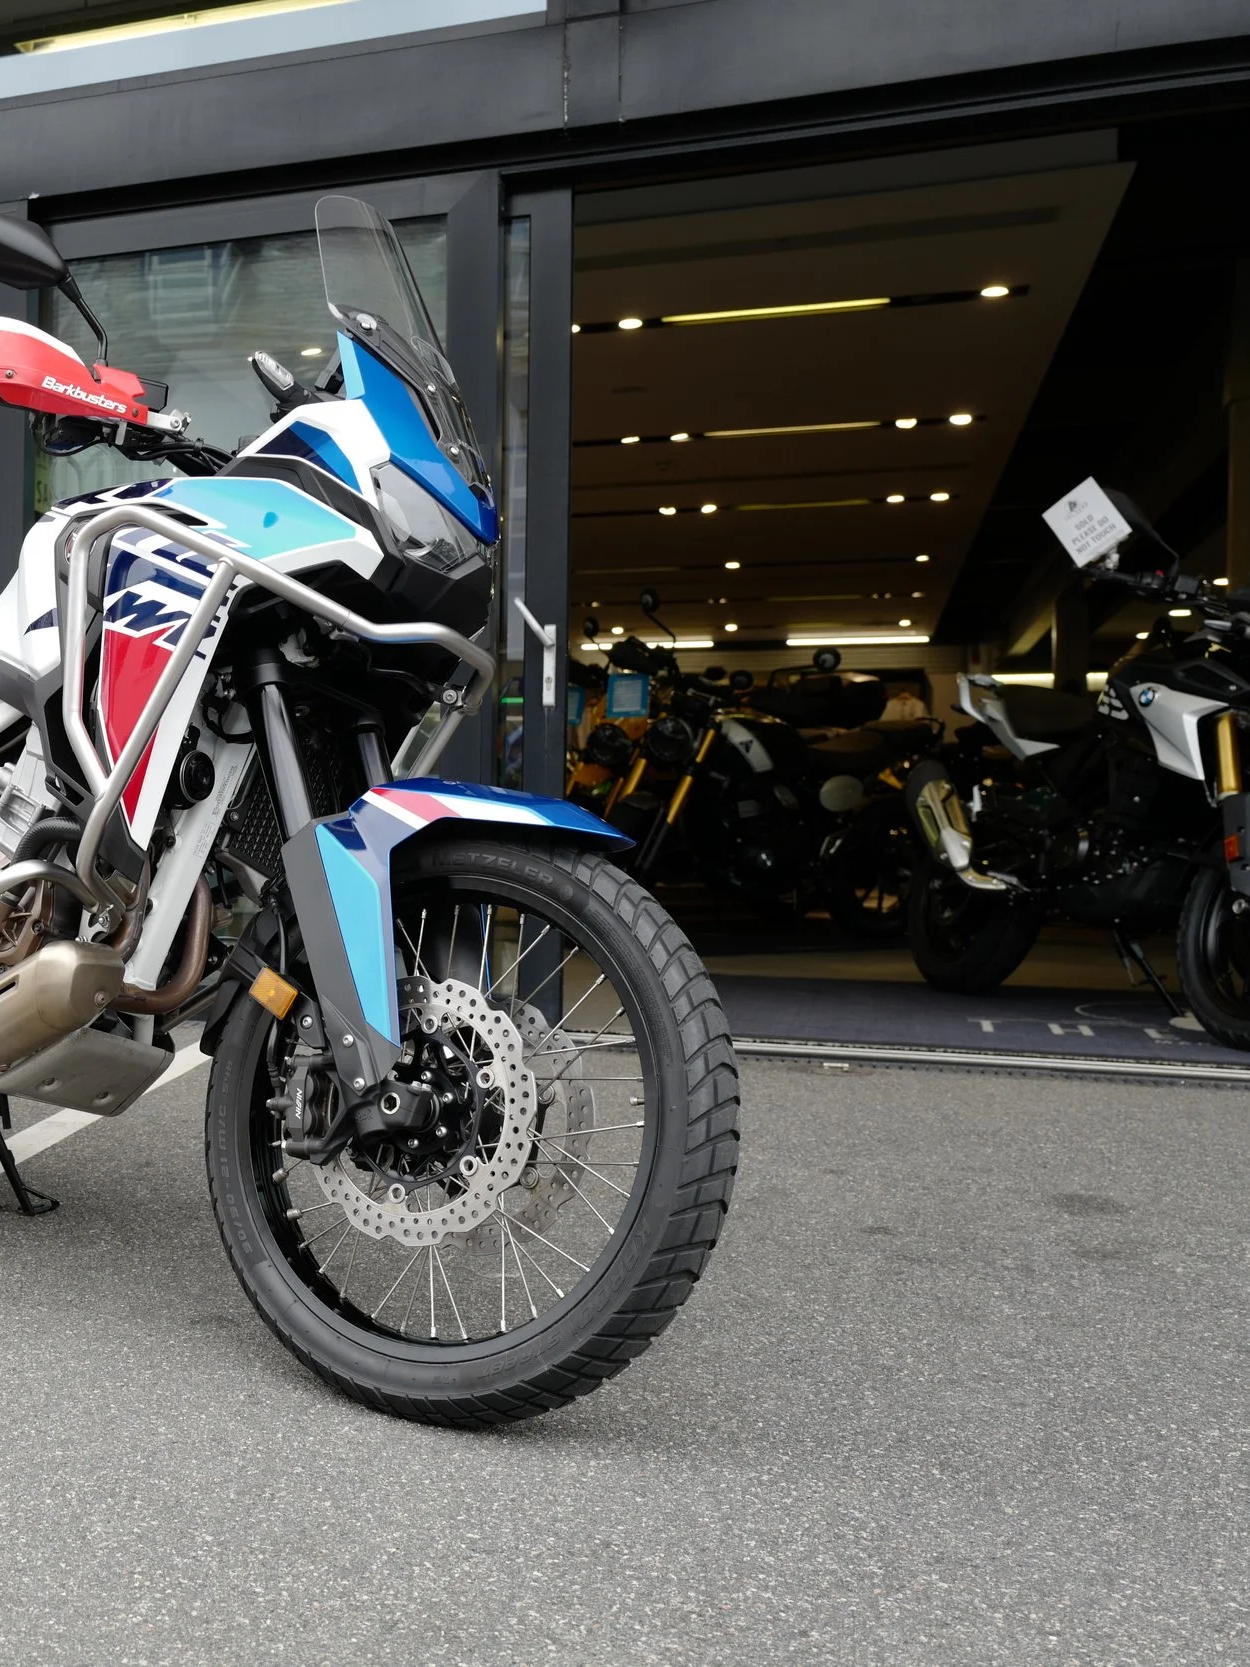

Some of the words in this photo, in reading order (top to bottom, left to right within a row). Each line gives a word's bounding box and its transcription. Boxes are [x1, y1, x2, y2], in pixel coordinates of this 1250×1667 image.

[41, 375, 128, 414] Barkbusters
[1071, 525, 1098, 545] PLEASE
[1097, 515, 1110, 528] DO
[1074, 514, 1095, 531] SOLD
[1076, 541, 1092, 554] NOT
[1091, 523, 1117, 543] TOUCH
[430, 852, 554, 885] METZELER
[294, 1087, 304, 1120] NISSIN
